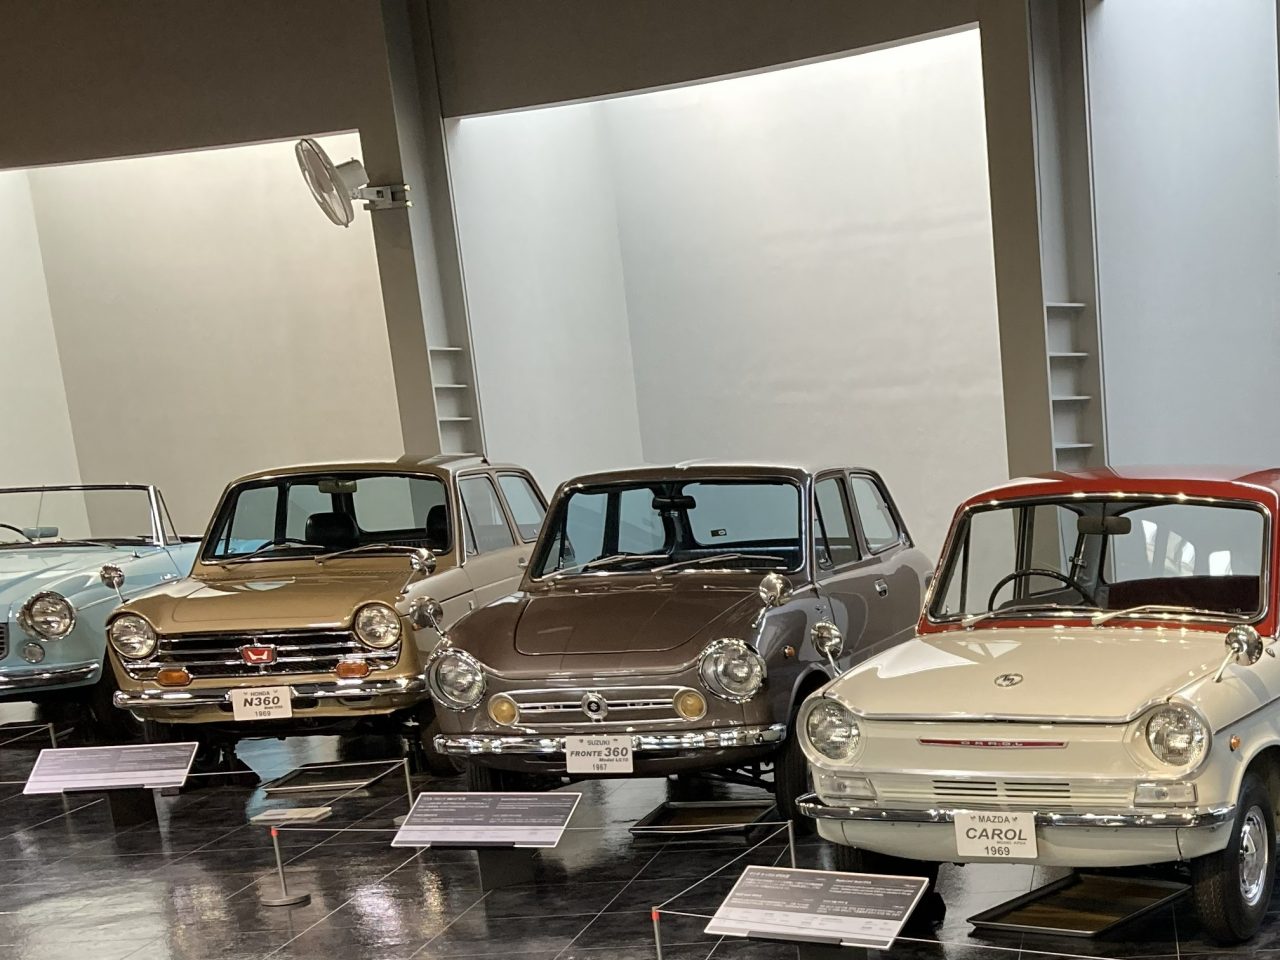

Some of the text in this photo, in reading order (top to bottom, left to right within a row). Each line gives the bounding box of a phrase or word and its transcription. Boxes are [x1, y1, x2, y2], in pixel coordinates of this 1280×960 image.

[244, 696, 280, 707] N360
[604, 747, 628, 757] 360
[978, 815, 1010, 824] MAZDA
[966, 828, 1027, 841] CAROL
[985, 846, 1010, 855] 1969
